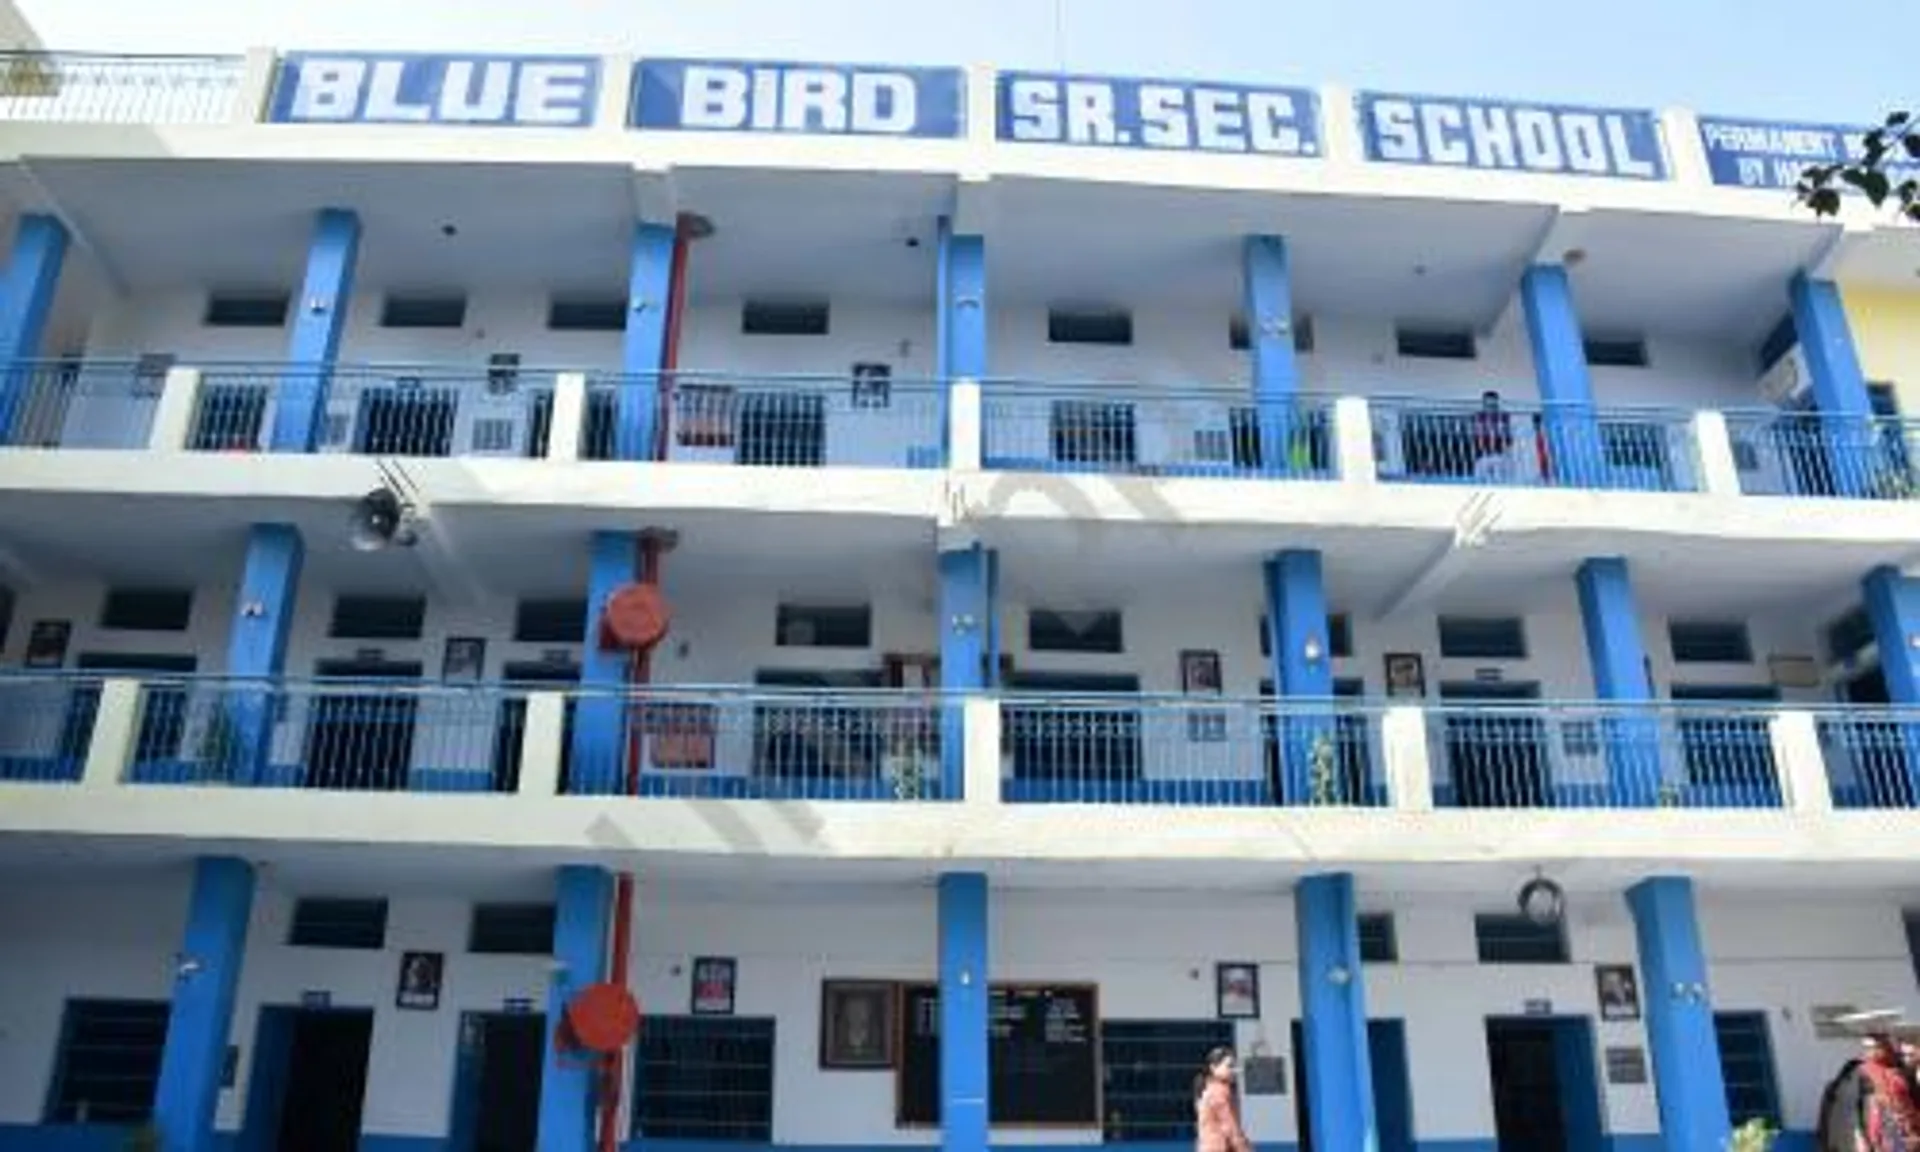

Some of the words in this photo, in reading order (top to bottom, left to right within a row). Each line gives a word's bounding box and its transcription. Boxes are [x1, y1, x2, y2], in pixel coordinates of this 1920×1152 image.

[292, 59, 588, 124] BLUE
[679, 65, 918, 133] BIRD
[1373, 99, 1656, 177] SCHOOL
[1703, 122, 1837, 162] PERMANENT
